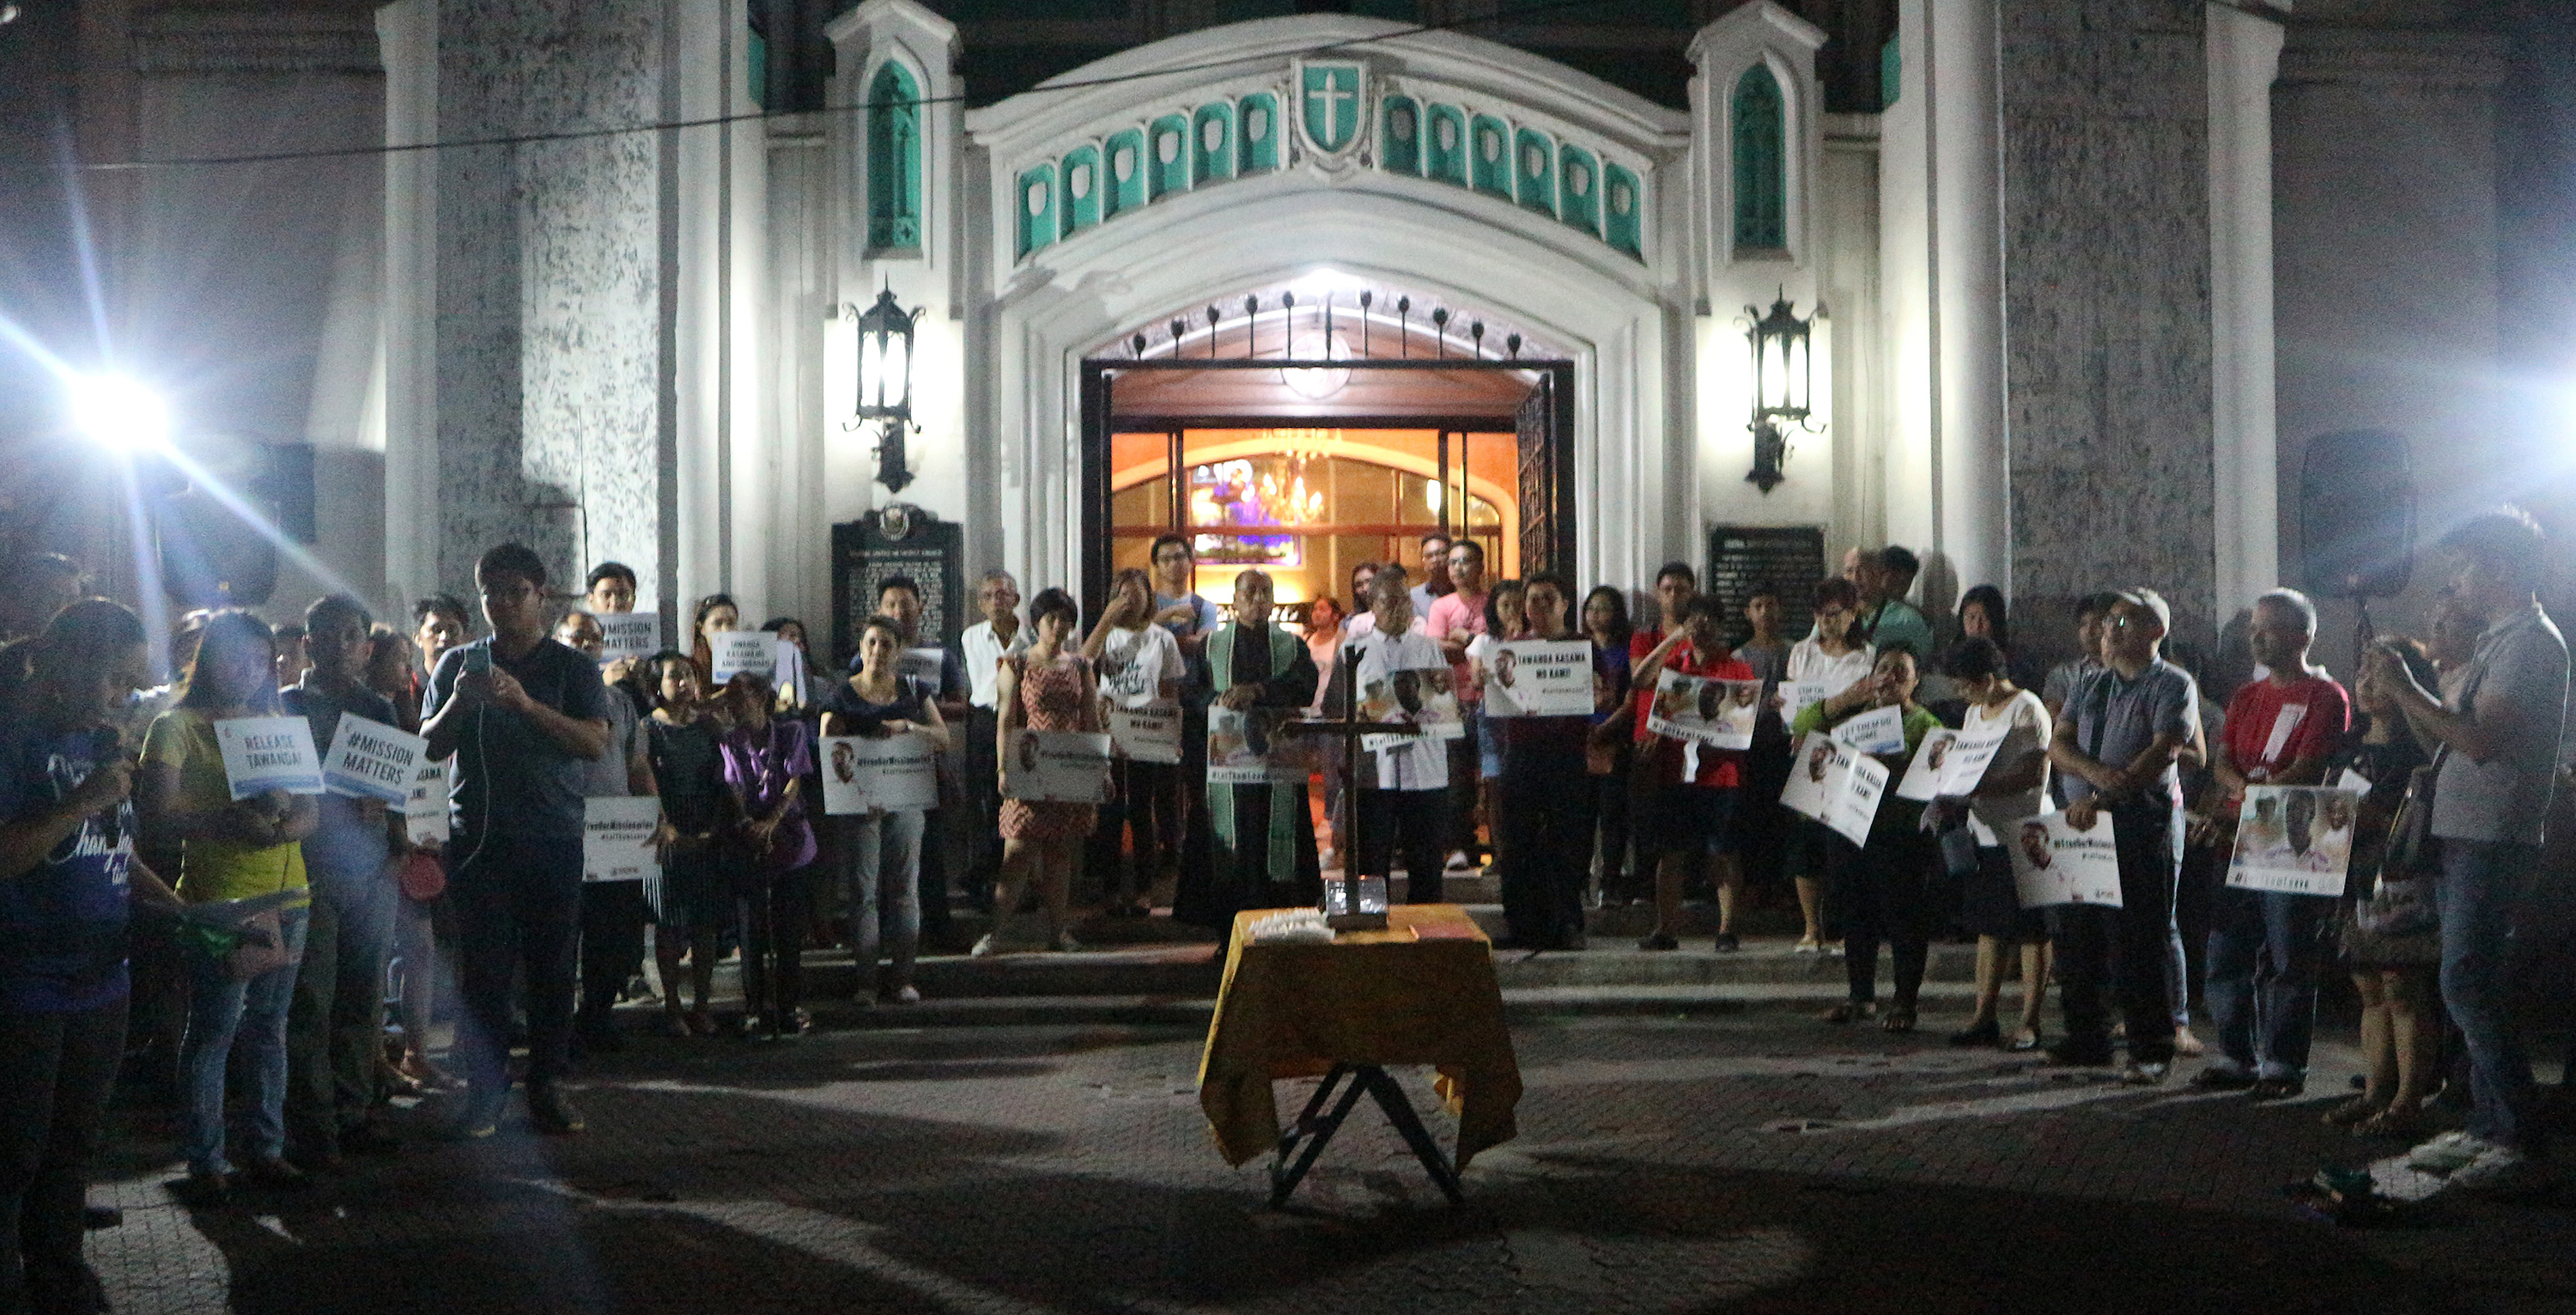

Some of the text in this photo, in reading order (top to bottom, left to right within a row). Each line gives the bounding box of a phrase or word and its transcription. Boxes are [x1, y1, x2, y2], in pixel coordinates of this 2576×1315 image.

[245, 734, 295, 750] RELEASE
[347, 731, 415, 767] #MISSION
[343, 752, 404, 785] MATTERS
